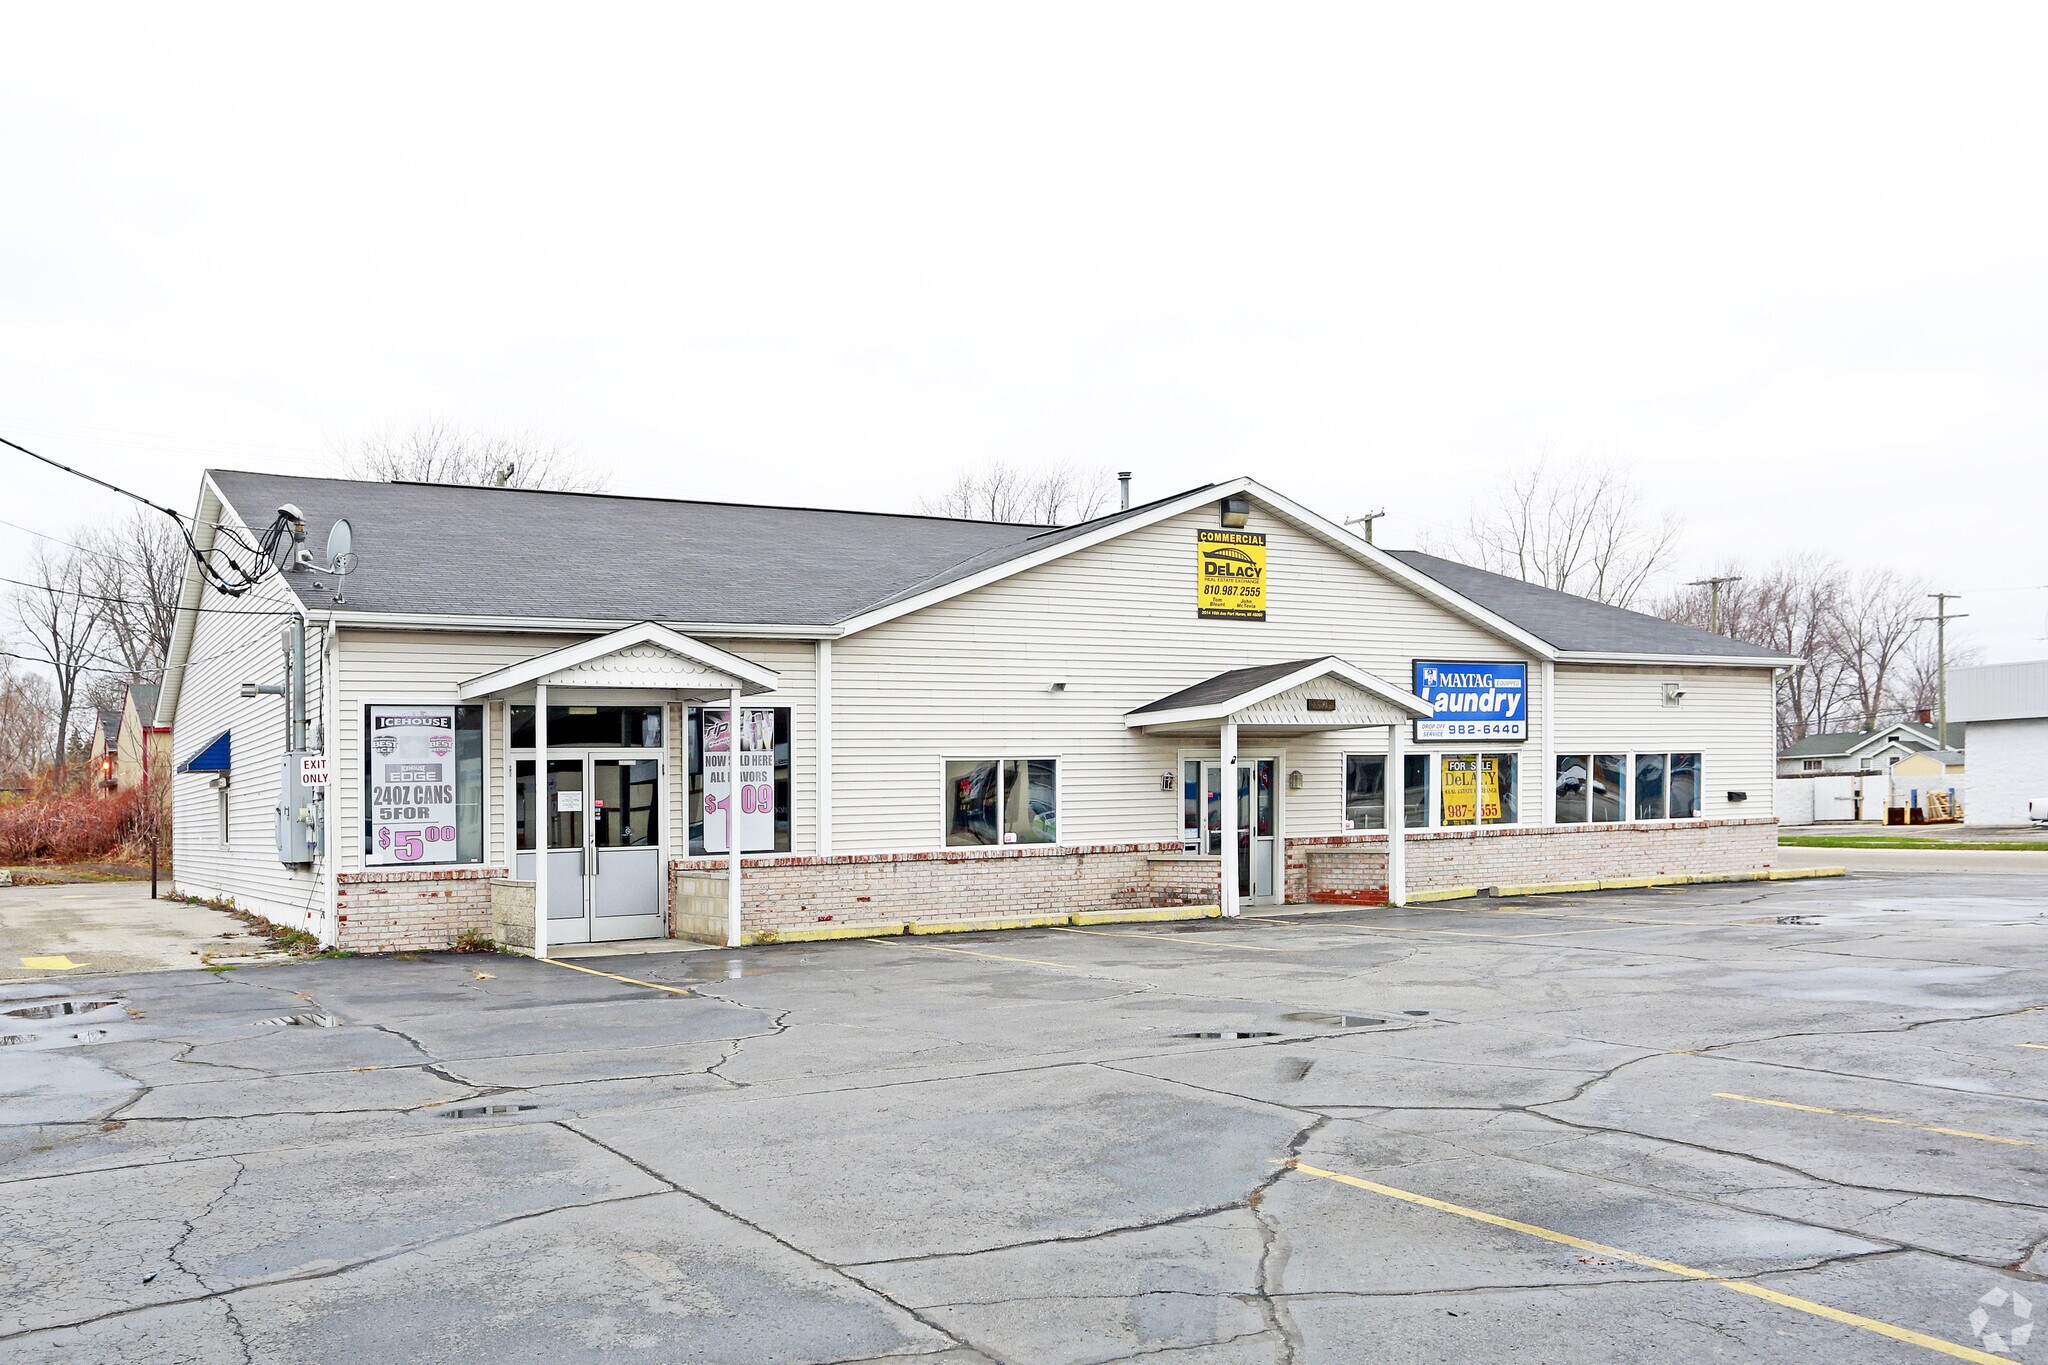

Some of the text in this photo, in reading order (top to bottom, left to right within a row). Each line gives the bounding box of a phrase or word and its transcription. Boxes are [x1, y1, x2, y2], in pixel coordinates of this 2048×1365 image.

[1200, 531, 1264, 545] COMMERCIAL
[1204, 584, 1261, 597] 810.987.2555
[1440, 673, 1493, 688] MAYTAG
[380, 717, 448, 728] ICEHOUSE
[1448, 724, 1519, 735] 982-6440
[373, 740, 398, 748] BEST
[429, 740, 453, 748] BEST
[303, 759, 327, 770] EXIT
[705, 755, 727, 768] NOW
[752, 754, 773, 767] HERE
[1449, 761, 1492, 771] FOR SLE
[302, 773, 329, 784] ONLY
[390, 772, 436, 782] EDGE
[710, 771, 726, 783] ALL
[413, 784, 453, 805] CANS
